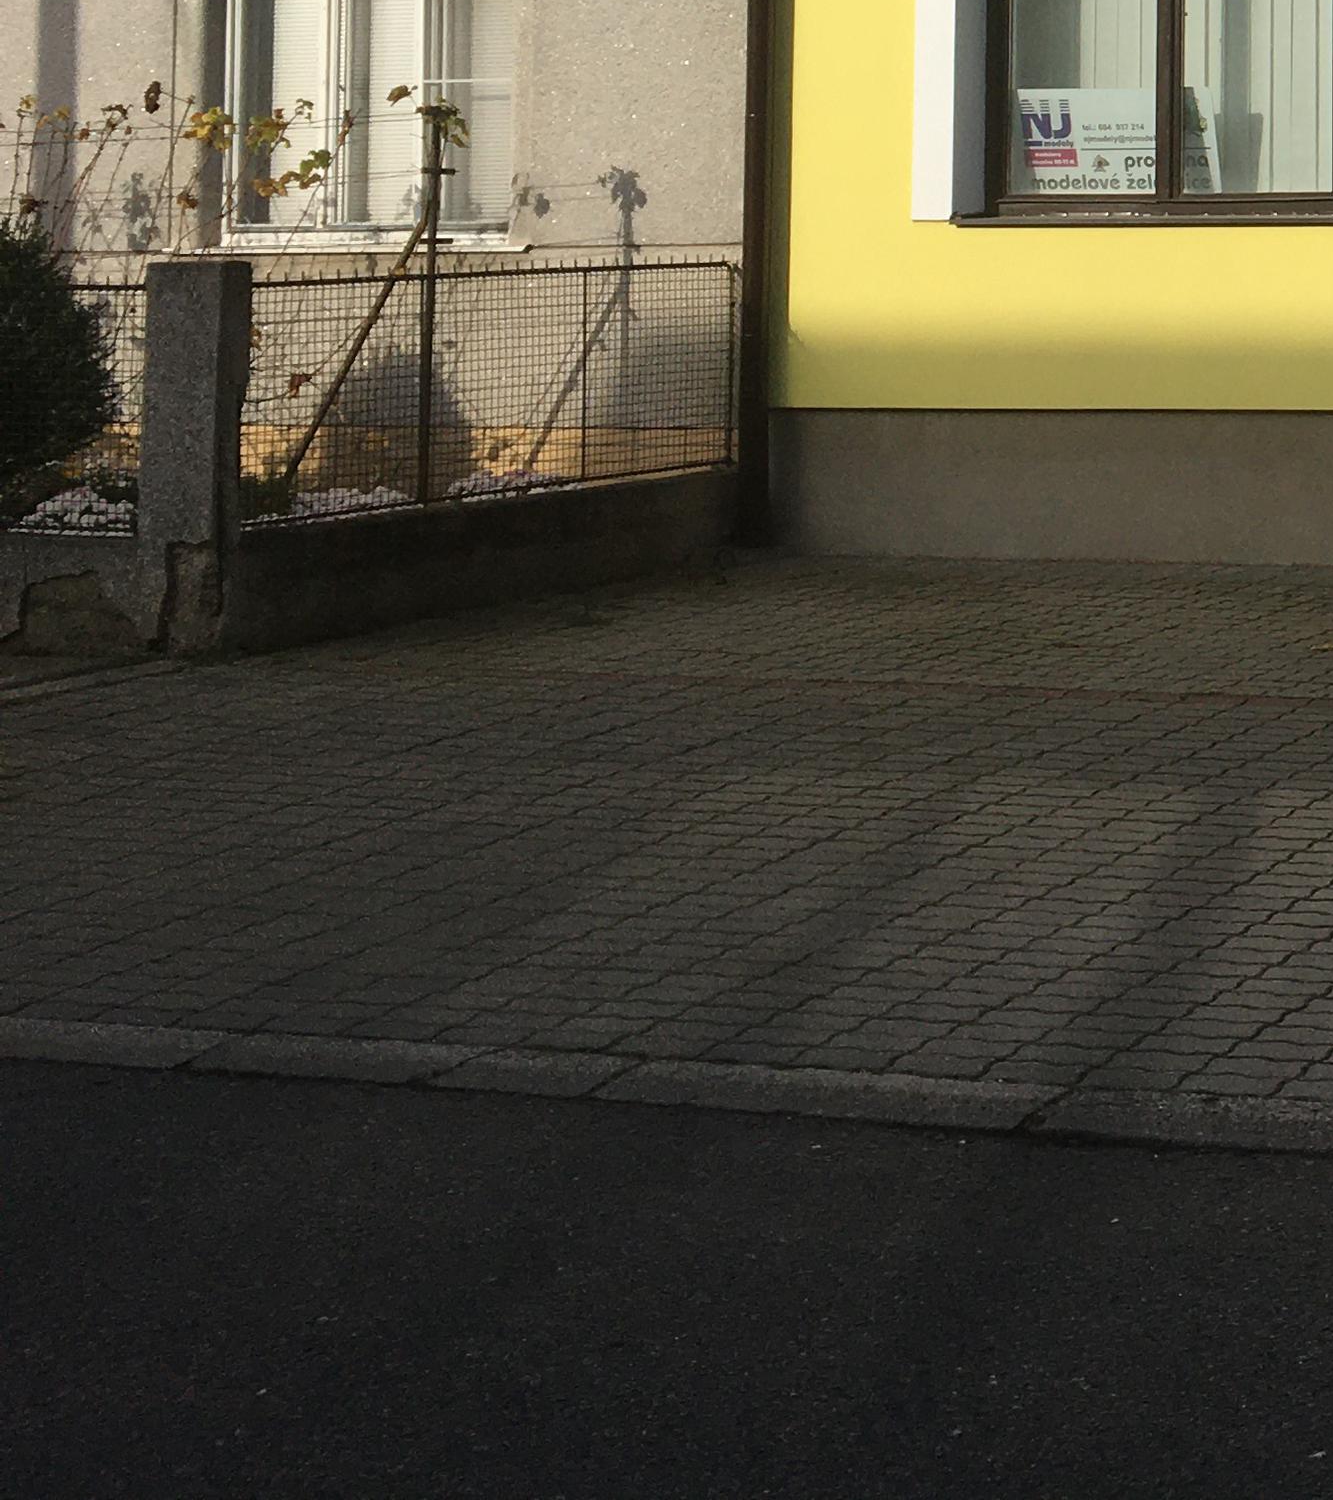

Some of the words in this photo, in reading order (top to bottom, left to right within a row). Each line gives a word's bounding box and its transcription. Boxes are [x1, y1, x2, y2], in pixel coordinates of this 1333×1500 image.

[1019, 99, 1072, 139] NJ
[1044, 140, 1074, 149] modely
[1032, 172, 1121, 191] modelové
